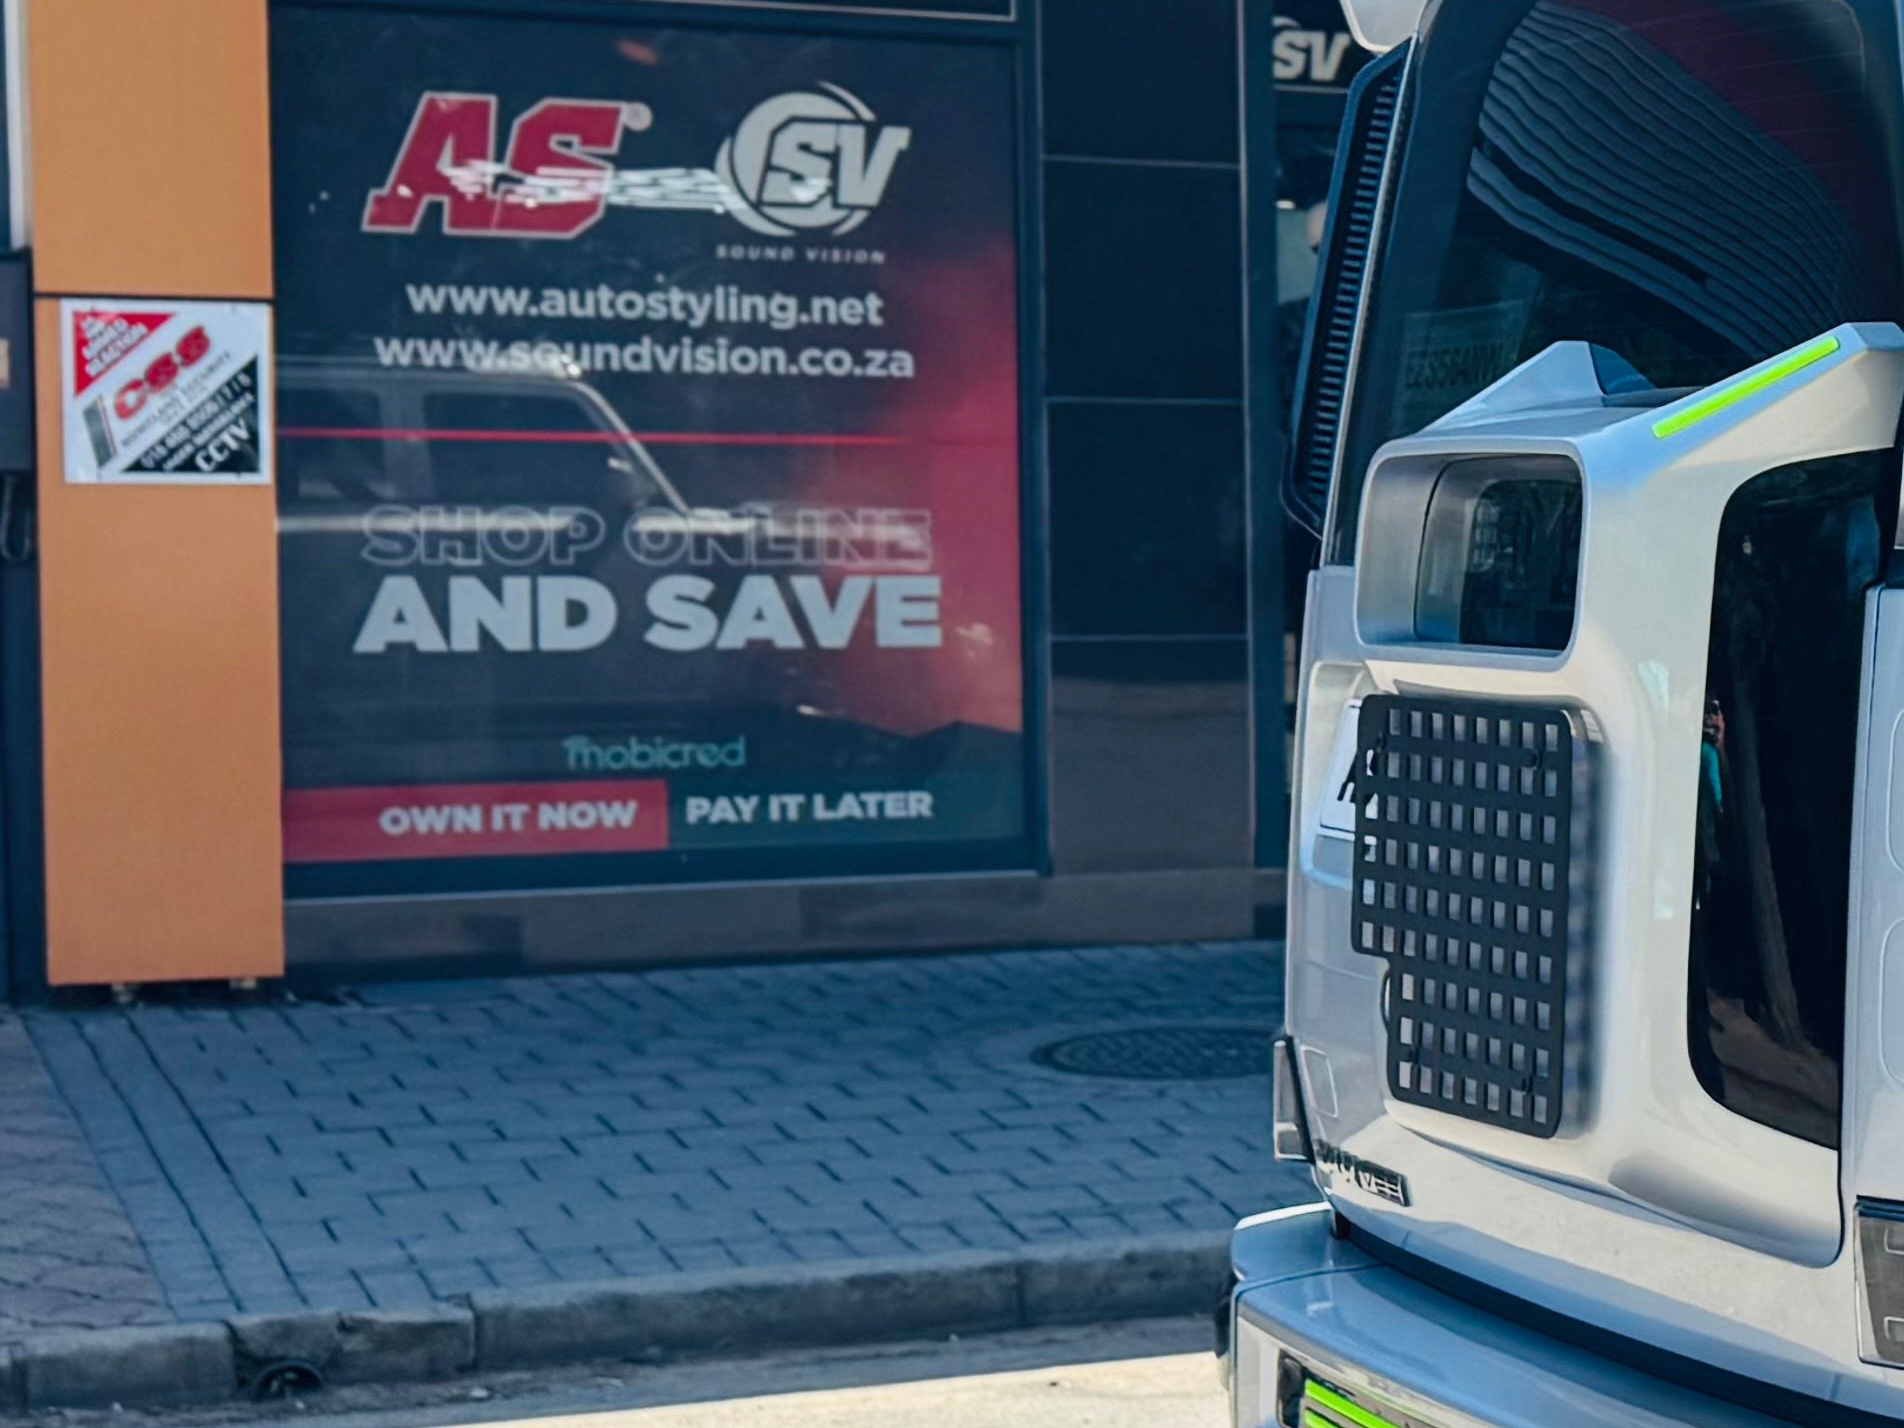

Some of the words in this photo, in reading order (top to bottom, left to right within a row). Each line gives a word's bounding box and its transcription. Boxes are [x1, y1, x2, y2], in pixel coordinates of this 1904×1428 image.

[760, 117, 911, 211] SV
[716, 244, 795, 261] SOUND
[805, 247, 886, 264] VISION
[406, 282, 884, 328] www.autostyling.net
[374, 335, 914, 377] www.soundvision.co.za
[195, 417, 253, 473] CCTV
[361, 504, 606, 568] SHOP
[624, 505, 932, 572] ONLINE
[352, 574, 617, 653] AND
[644, 574, 942, 652] SAVE
[379, 804, 482, 836] OWN
[491, 803, 529, 832] IT
[538, 799, 638, 830] NOW
[685, 794, 756, 825] PAY
[769, 793, 806, 822] IT
[814, 790, 933, 821] LATER
